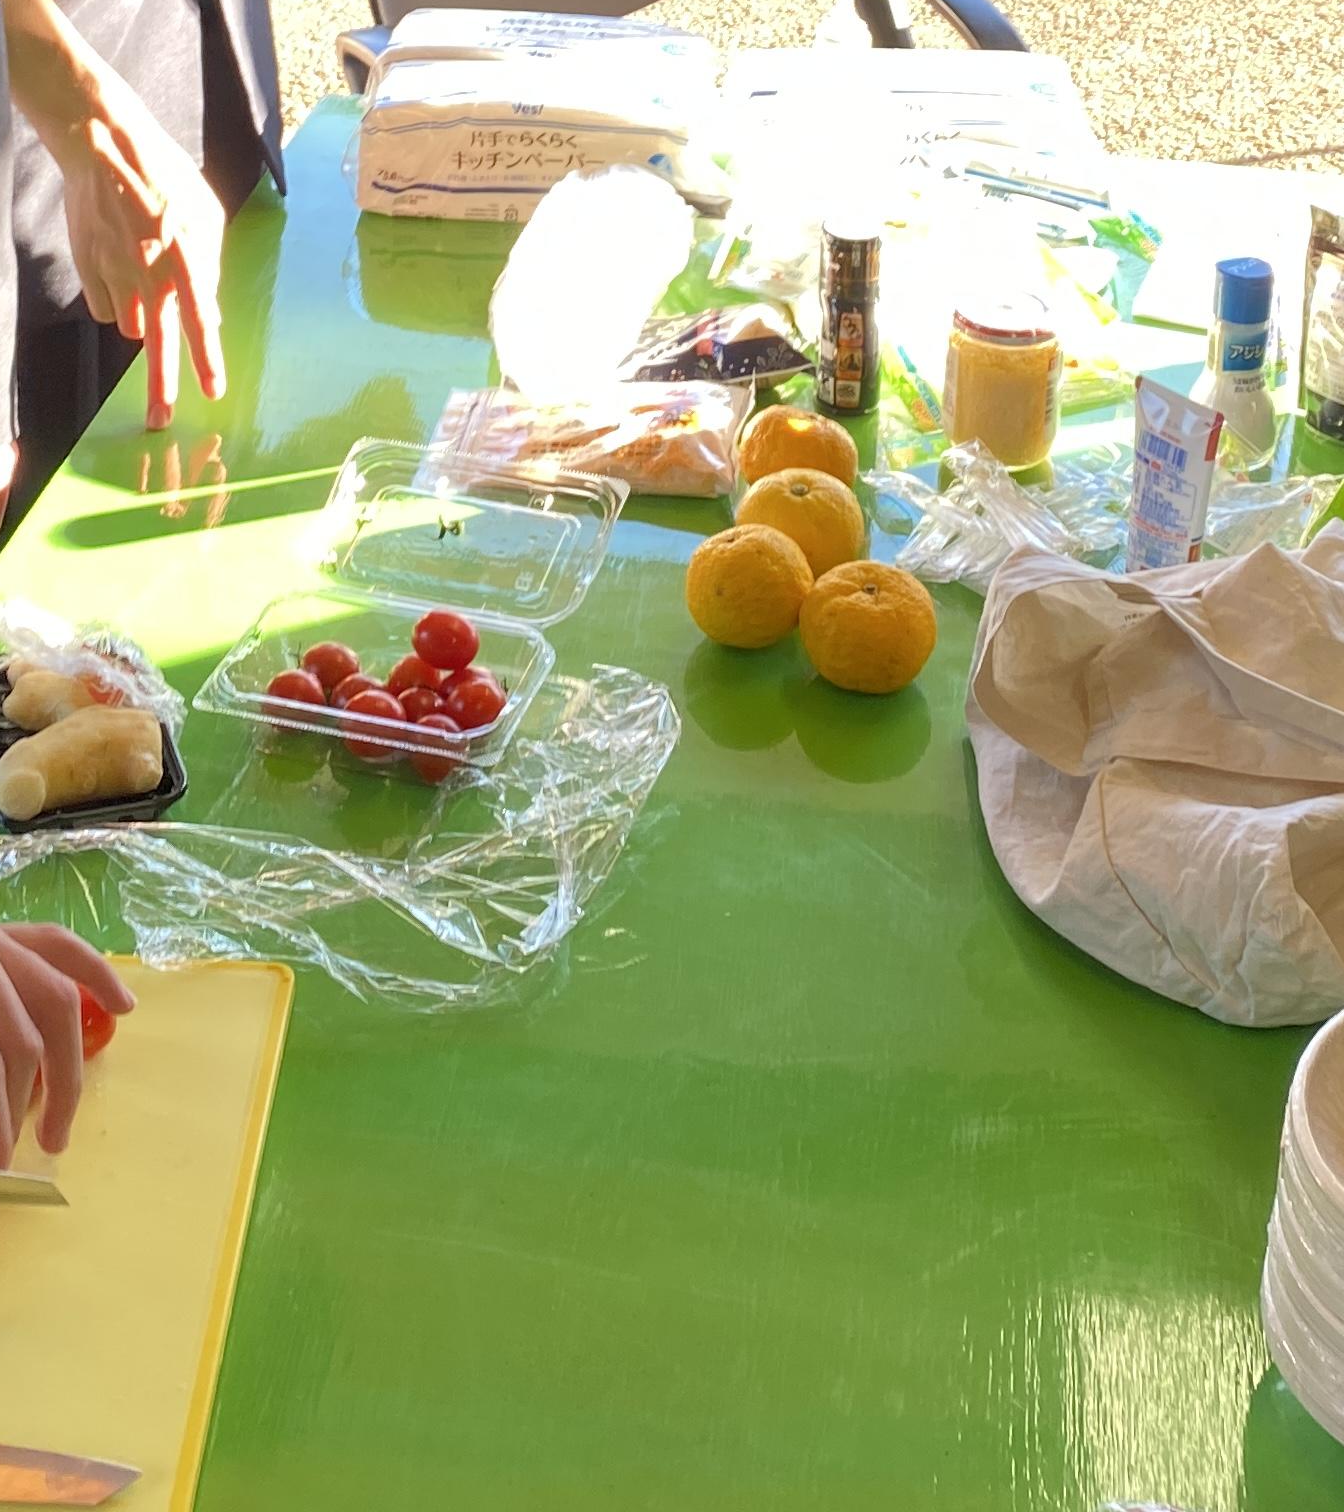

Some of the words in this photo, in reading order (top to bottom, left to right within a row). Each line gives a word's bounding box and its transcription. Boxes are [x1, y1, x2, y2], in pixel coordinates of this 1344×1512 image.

[470, 130, 578, 149] 片手でらくらく
